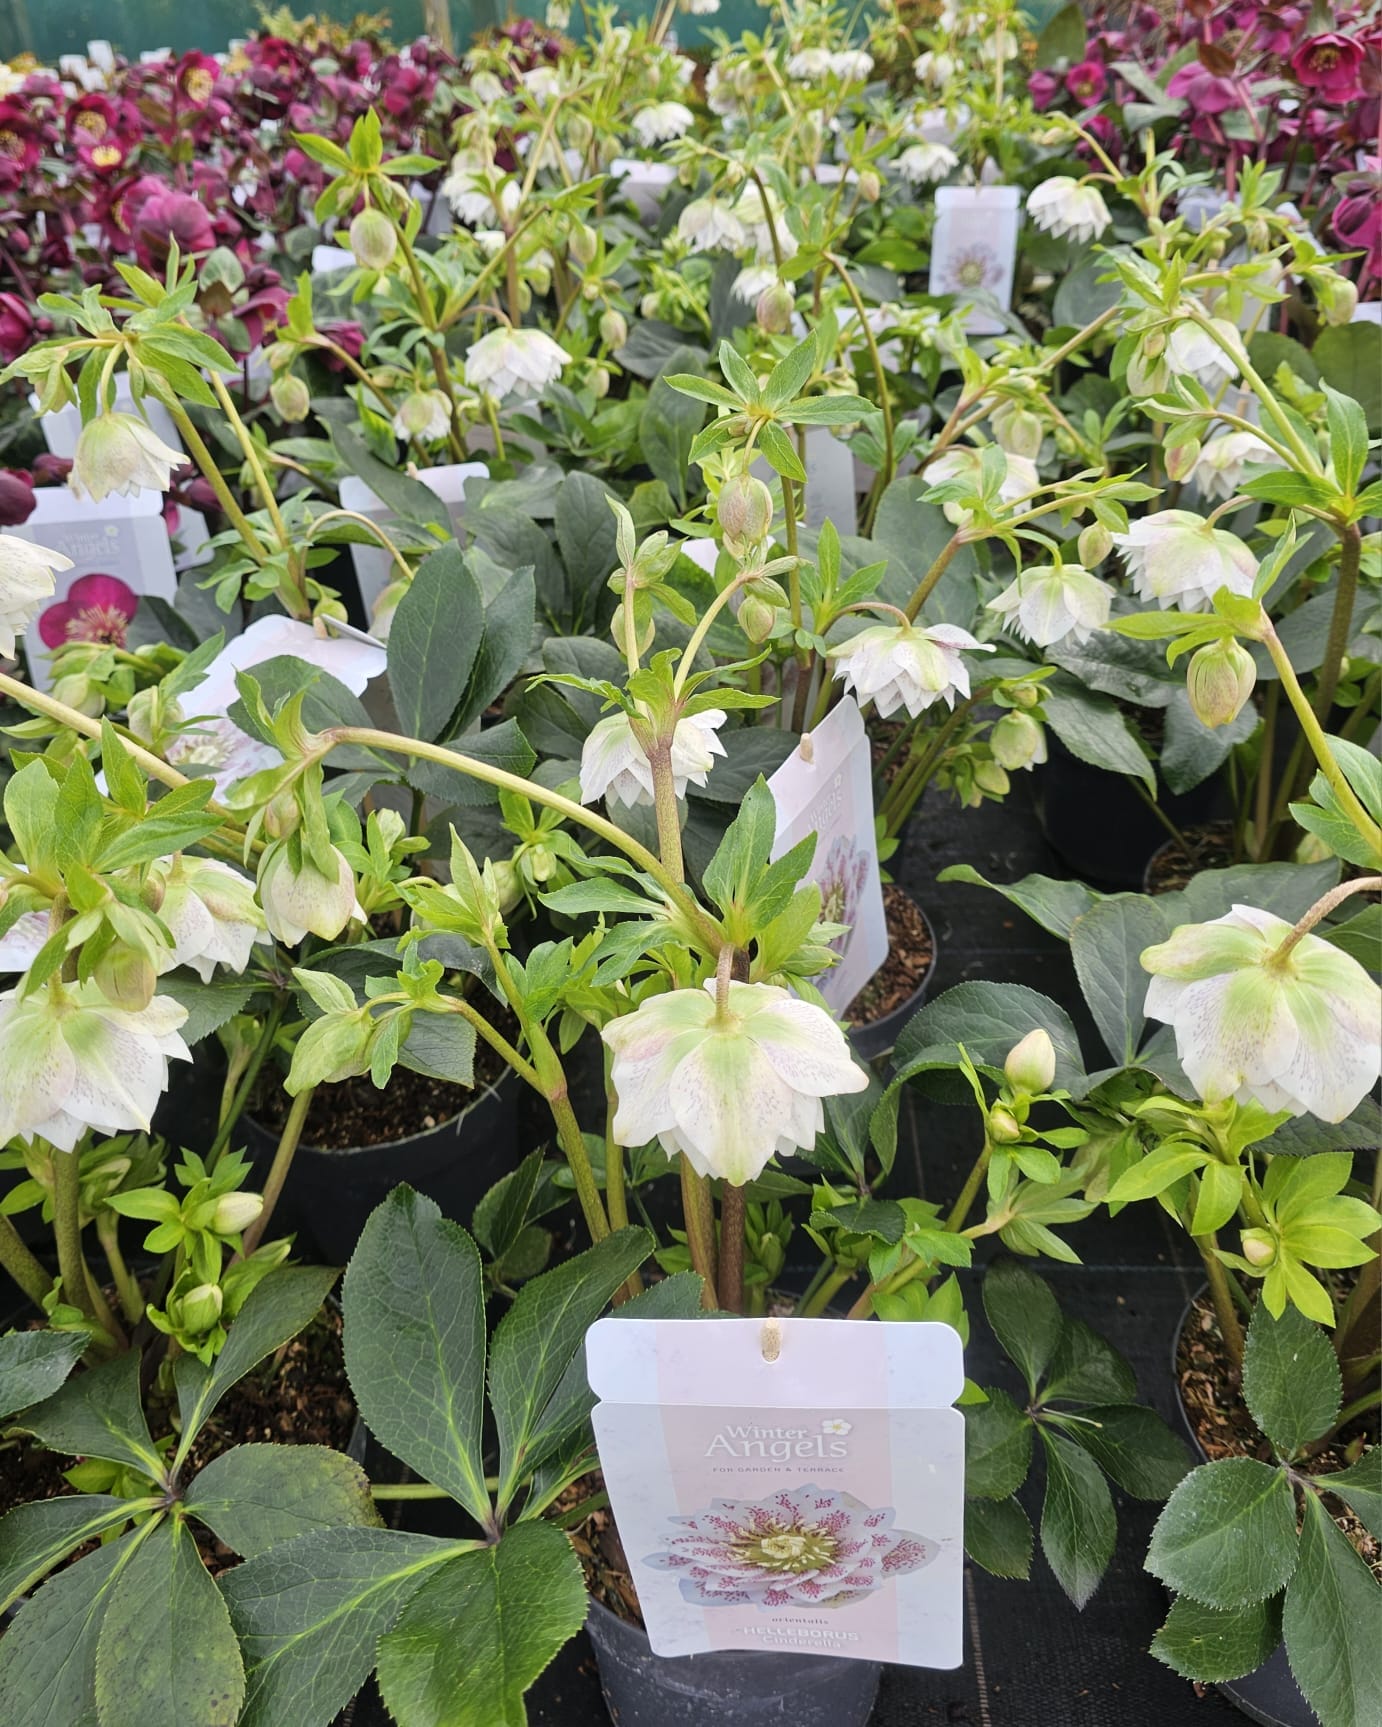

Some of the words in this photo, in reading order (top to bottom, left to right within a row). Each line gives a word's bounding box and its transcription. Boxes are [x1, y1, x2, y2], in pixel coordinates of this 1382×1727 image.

[725, 1424, 808, 1440] Winter
[704, 1433, 848, 1463] Angels
[771, 1616, 829, 1625] orientalis
[743, 1626, 859, 1641] HELLEBORUS
[762, 1635, 841, 1649] Cinderella
